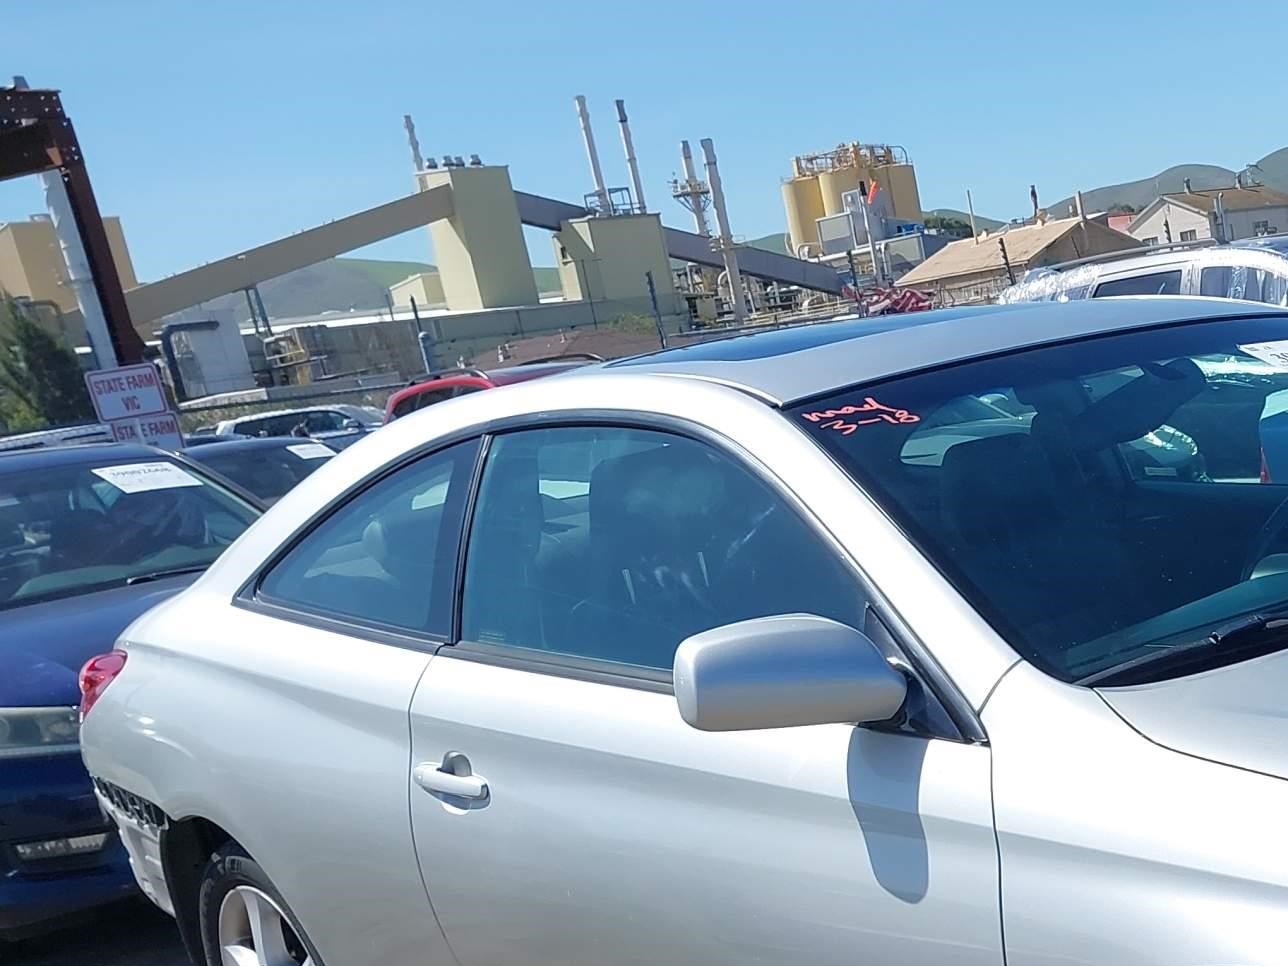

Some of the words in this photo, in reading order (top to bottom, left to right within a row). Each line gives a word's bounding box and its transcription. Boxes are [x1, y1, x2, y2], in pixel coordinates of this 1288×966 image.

[93, 377, 126, 396] STATE
[126, 372, 155, 390] FARM
[121, 395, 141, 412] VIC
[116, 424, 149, 441] STAE
[149, 420, 177, 438] FARM
[820, 409, 921, 436] 3-18
